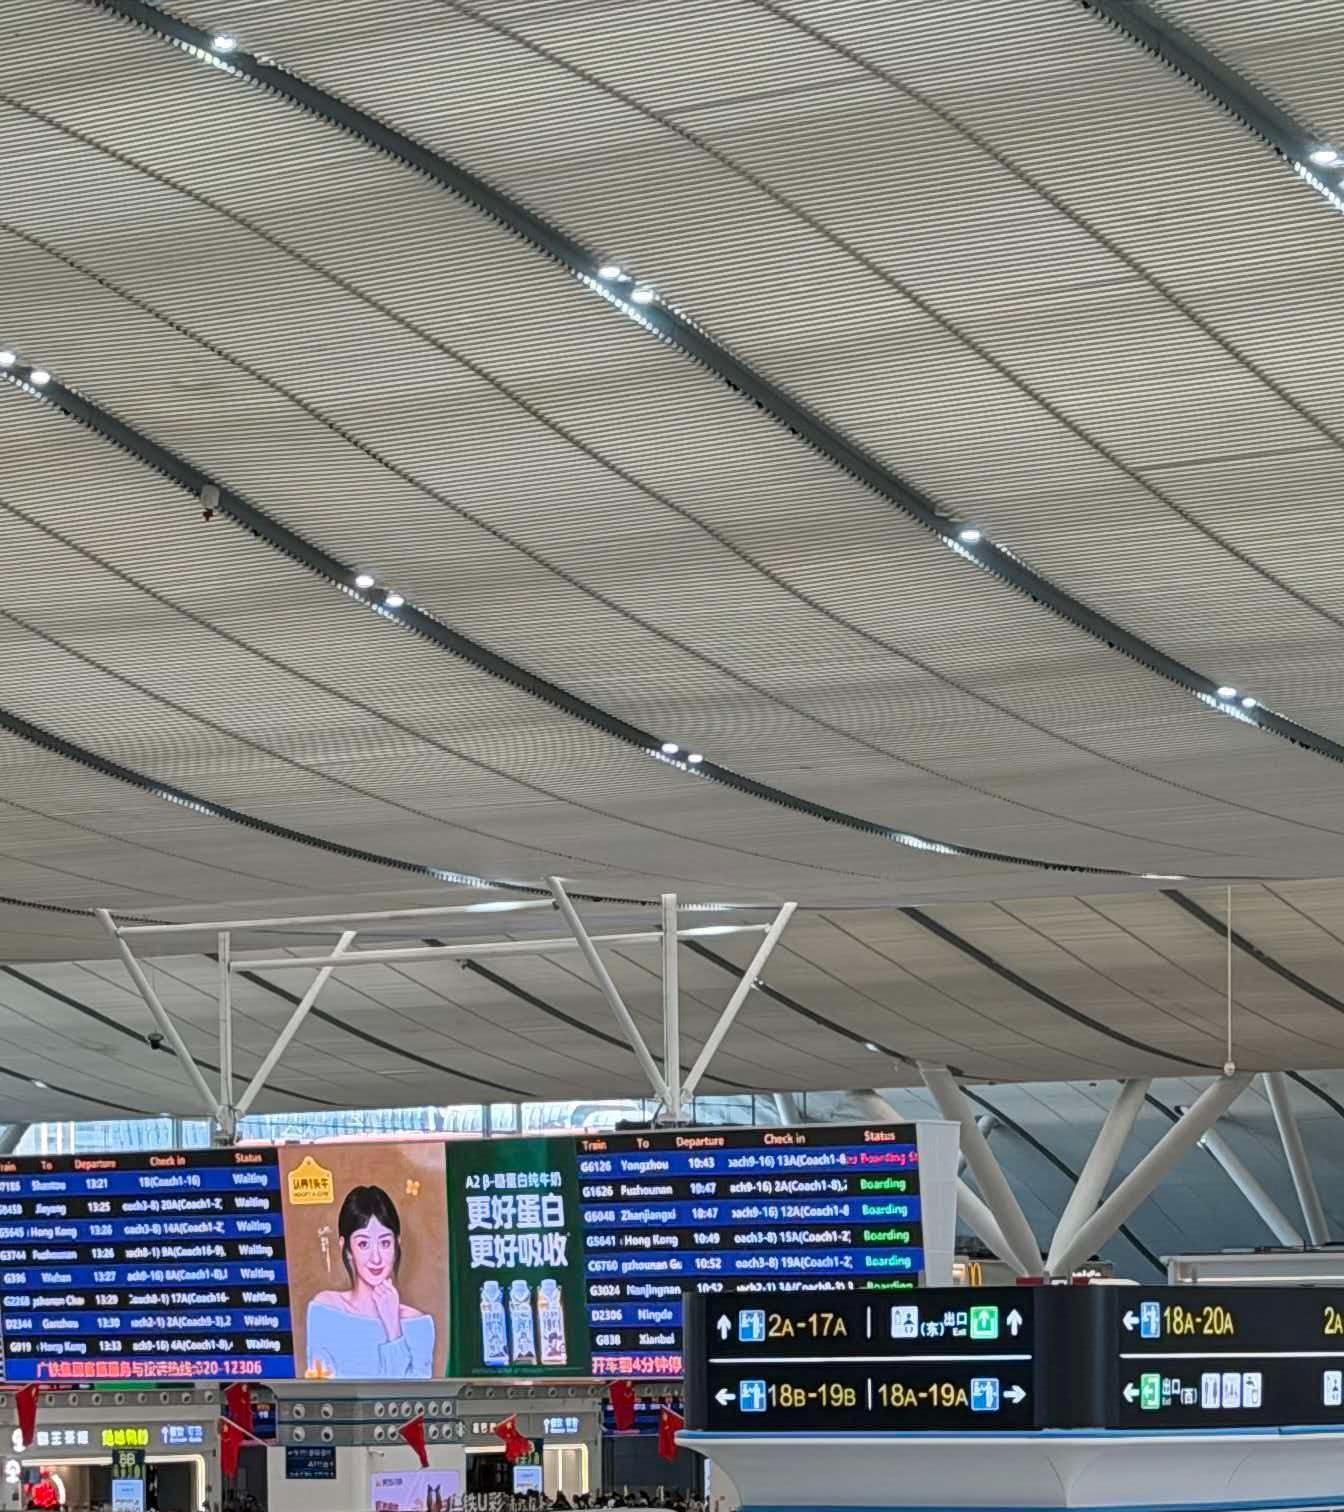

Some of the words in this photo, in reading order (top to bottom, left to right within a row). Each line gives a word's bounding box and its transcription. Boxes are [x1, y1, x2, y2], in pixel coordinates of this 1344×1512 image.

[582, 1140, 607, 1151] Train
[636, 1138, 650, 1149] To
[676, 1136, 725, 1149] Departure
[763, 1133, 793, 1145] Check
[864, 1130, 895, 1142] Status
[688, 1157, 715, 1169] 10:43
[232, 1173, 268, 1186] Waiting
[860, 1178, 906, 1191] Boarding
[234, 1196, 270, 1210] Waiting
[862, 1203, 908, 1217] Boarding
[466, 1193, 565, 1230] 更好蛋白
[236, 1220, 272, 1234] Waiting
[624, 1235, 651, 1248] Hong
[652, 1233, 679, 1247] Kong
[693, 1232, 721, 1245] 10:49
[863, 1228, 910, 1243] Boarding
[238, 1244, 274, 1258] Waiting
[470, 1233, 568, 1268] 更好吸收
[695, 1257, 722, 1270] 10:52
[865, 1255, 912, 1269] Boarding
[240, 1267, 276, 1281] Waiting
[242, 1291, 278, 1305] Waiting
[243, 1315, 280, 1328] Waiting
[592, 1309, 623, 1321] D2306
[944, 1312, 968, 1327] 出口
[1163, 1306, 1234, 1335] 18A-20A
[768, 1313, 848, 1337] 2A-17A
[245, 1339, 281, 1352] Waiting
[767, 1382, 857, 1408] 18B-19B
[878, 1382, 969, 1408] 18A-19A
